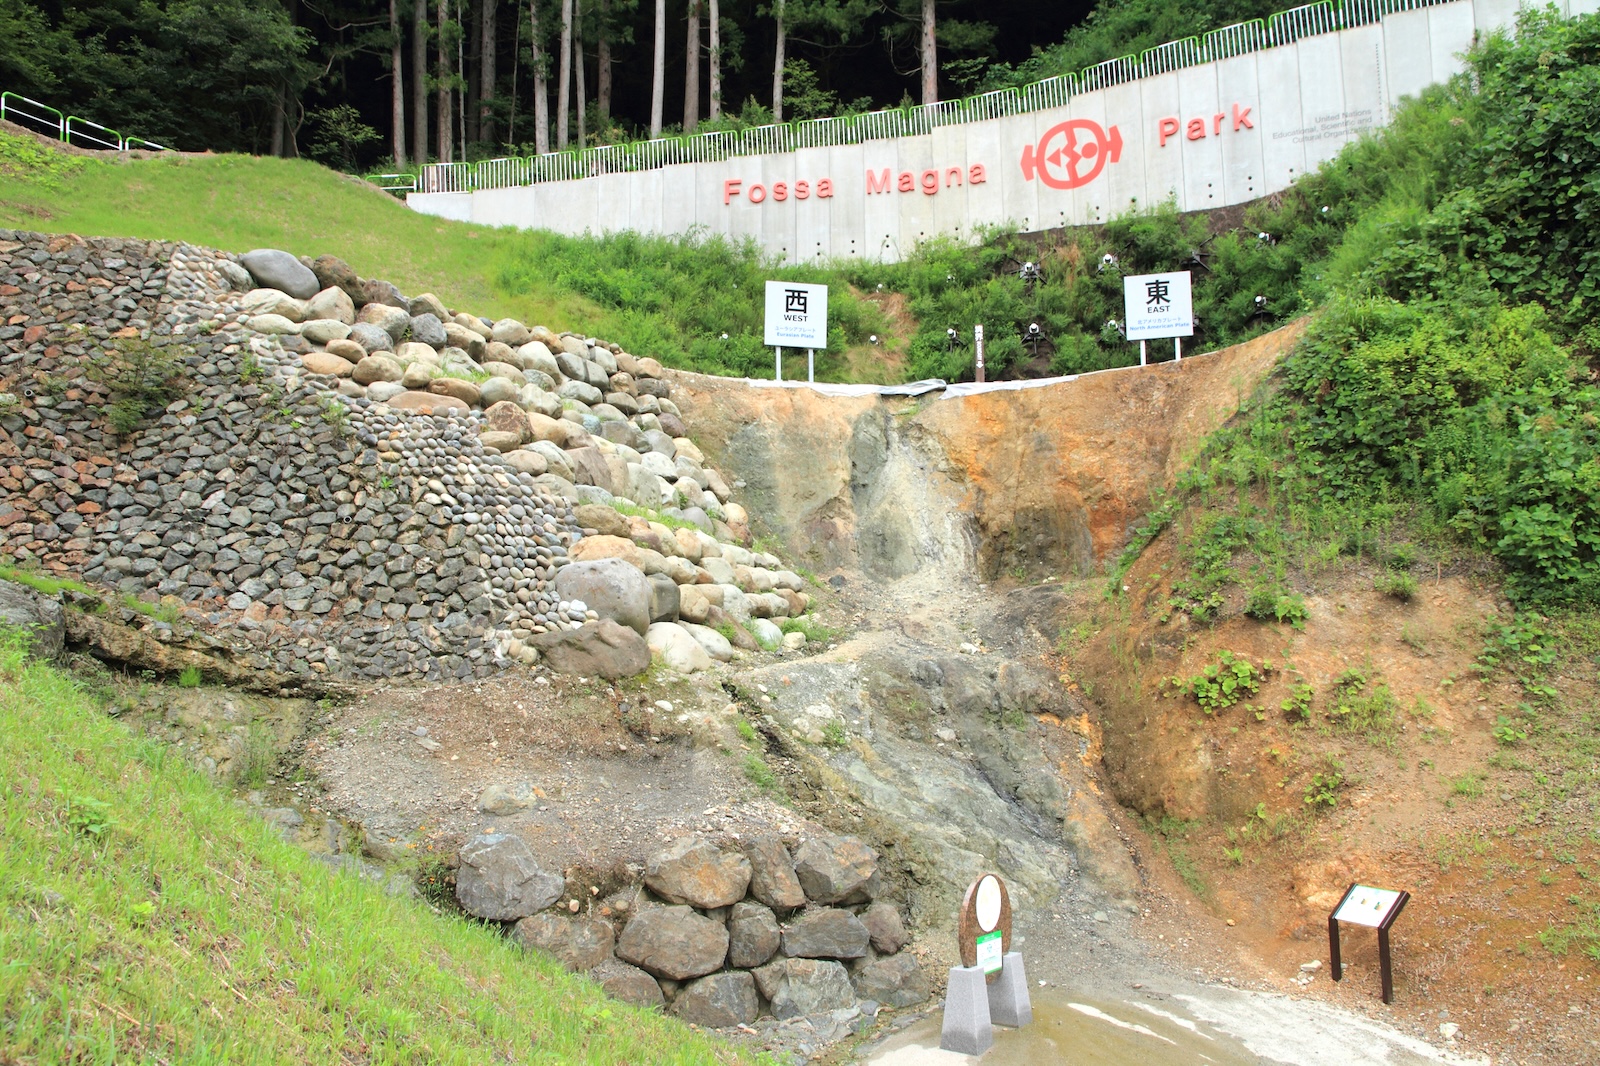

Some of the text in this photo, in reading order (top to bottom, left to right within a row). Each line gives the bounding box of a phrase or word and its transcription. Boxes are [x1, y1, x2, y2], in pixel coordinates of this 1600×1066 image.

[1314, 109, 1372, 123] United Nations
[1320, 120, 1355, 131] Scientific
[1357, 116, 1373, 124] and
[1292, 133, 1321, 144] Cultural
[724, 102, 1254, 206] Fossa Magna Park
[1144, 279, 1171, 305] 東
[784, 288, 809, 314] 西
[1147, 305, 1171, 314] EAST
[783, 314, 809, 322] WEST
